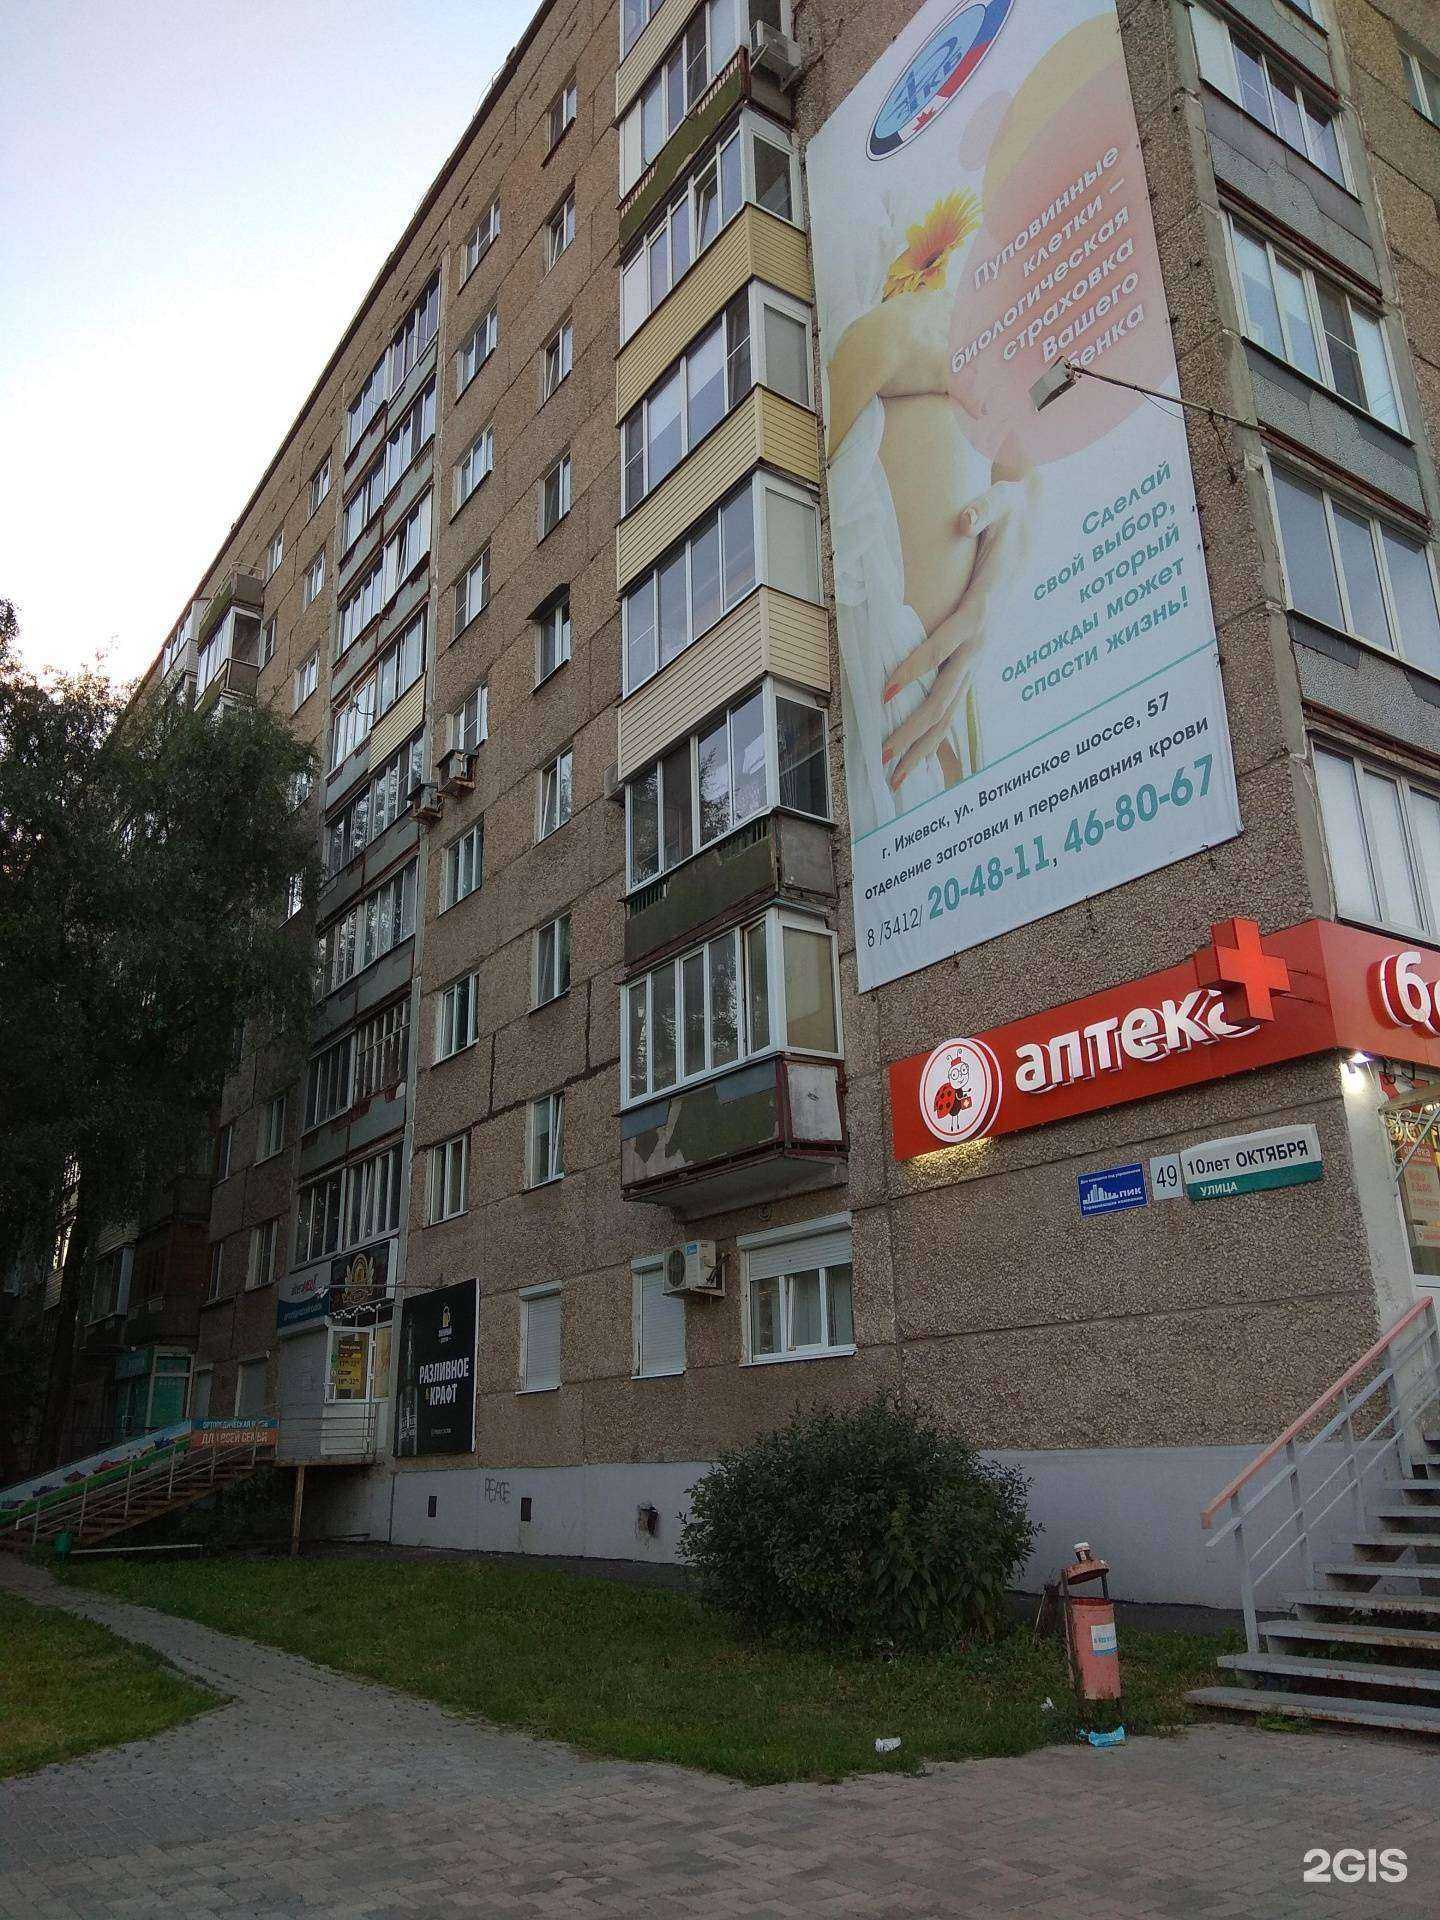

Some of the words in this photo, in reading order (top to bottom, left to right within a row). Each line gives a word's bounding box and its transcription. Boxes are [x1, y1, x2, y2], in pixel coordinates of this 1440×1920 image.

[973, 147, 1120, 290] Пуповинные
[1022, 195, 1103, 278] клетки
[951, 206, 1129, 374] биологическая
[1003, 239, 1135, 361] страховка
[1041, 272, 1140, 362] Вашего
[1081, 461, 1172, 535] Сделай
[1033, 553, 1085, 601] свой
[1091, 500, 1176, 563] выбор,
[1079, 523, 1180, 603] который
[1001, 612, 1099, 682] однажды
[1105, 557, 1185, 620] может
[1020, 645, 1098, 701] спасти
[1104, 586, 1189, 654] жизнь!
[864, 860, 933, 901] отделение
[936, 818, 1010, 864] заготовки
[1013, 812, 1024, 828] и
[1028, 751, 1143, 822] переливания
[1148, 717, 1209, 760] крови
[881, 845, 892, 860] г.
[894, 816, 951, 853] Ижевск,
[953, 802, 975, 826] ул.
[978, 750, 1071, 809] Воткинское
[1075, 711, 1142, 757] шоссе,
[1146, 691, 1170, 718] 57
[866, 928, 876, 948] 8
[927, 835, 1058, 921] 20-48-11,
[1063, 753, 1214, 854] 46-80-67
[1382, 951, 1440, 1036] б
[1119, 1187, 1142, 1198] ПИК
[1156, 1165, 1178, 1188] 49
[1187, 1158, 1231, 1176] 10лет
[1235, 1140, 1309, 1168] ОКТЯБРЯ
[1200, 1182, 1238, 1197] УЛИЦА
[419, 1357, 470, 1385] РАЗЛИВНОЕ
